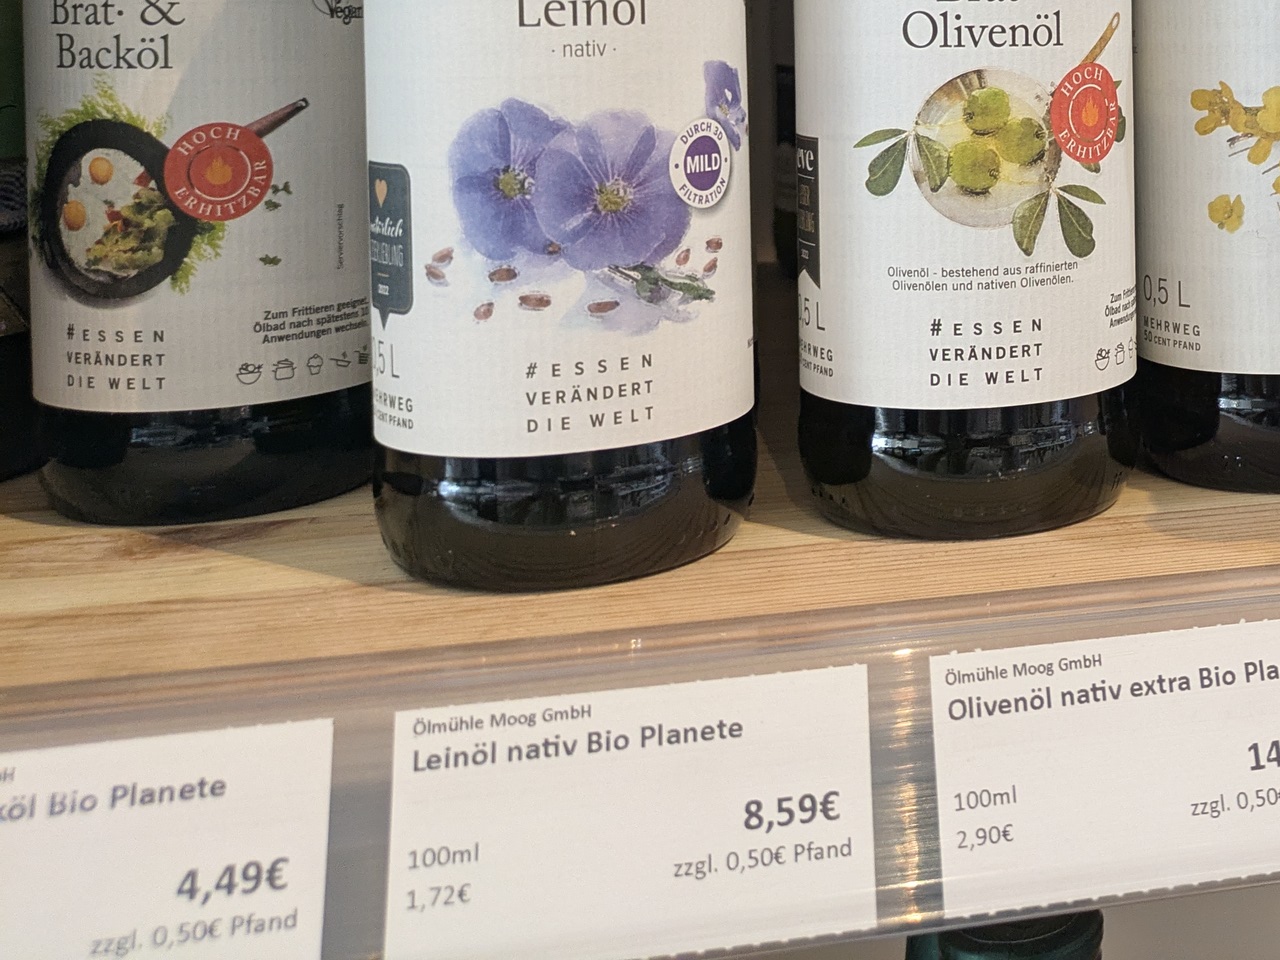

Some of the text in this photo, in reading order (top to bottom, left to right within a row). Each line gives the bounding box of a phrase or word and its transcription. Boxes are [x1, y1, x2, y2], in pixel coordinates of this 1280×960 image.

[902, 10, 1064, 48] Olivenöl
[56, 34, 173, 69] Backöl
[563, 41, 607, 58] nativ
[1061, 67, 1102, 96] HOCH
[177, 126, 240, 157] HOCH
[680, 122, 723, 144] DURCH 3D
[1058, 101, 1115, 159] ERHITZBAR
[686, 153, 720, 173] MILD
[175, 159, 266, 216] ERHITZBAR
[679, 177, 726, 204] FILTRATION
[888, 266, 929, 278] Olivenöl
[941, 266, 999, 278] bestehend
[1003, 268, 1022, 276] aus
[1025, 261, 1078, 275] raffinierten
[892, 274, 1074, 291] Olivenölen und nativen Olivenölen.
[1144, 275, 1190, 308] 0,5 L
[67, 324, 164, 342] #ESSEN
[253, 321, 285, 333] Ölbad
[289, 318, 313, 329] nach
[1143, 316, 1200, 336] MEHRWEG
[929, 343, 1043, 362] VERÄNDERT
[1144, 330, 1201, 351] 50 CENT PFAND
[67, 350, 165, 367] VERÄNDERT
[67, 375, 165, 390] DIE WELT
[930, 368, 1043, 386] DIE WELT
[526, 380, 653, 406] VERÄNDERT
[527, 407, 654, 433] DIE WELT
[944, 653, 1103, 686] Ölmühle Moog GmbH
[947, 688, 1053, 721] Olivenöl
[1060, 679, 1121, 709] nativ
[1130, 673, 1191, 698] extra
[1198, 665, 1237, 690] Bio
[413, 718, 744, 772] Leinöl nativ Bio Planete
[49, 776, 227, 818] Bio Planete
[953, 785, 1018, 812] 100ml
[1190, 794, 1231, 819] zzgl.
[743, 790, 841, 835] 8,59€
[957, 823, 1015, 852] 2,90€
[176, 856, 290, 906] 4,49€
[405, 883, 473, 912] 1,72€
